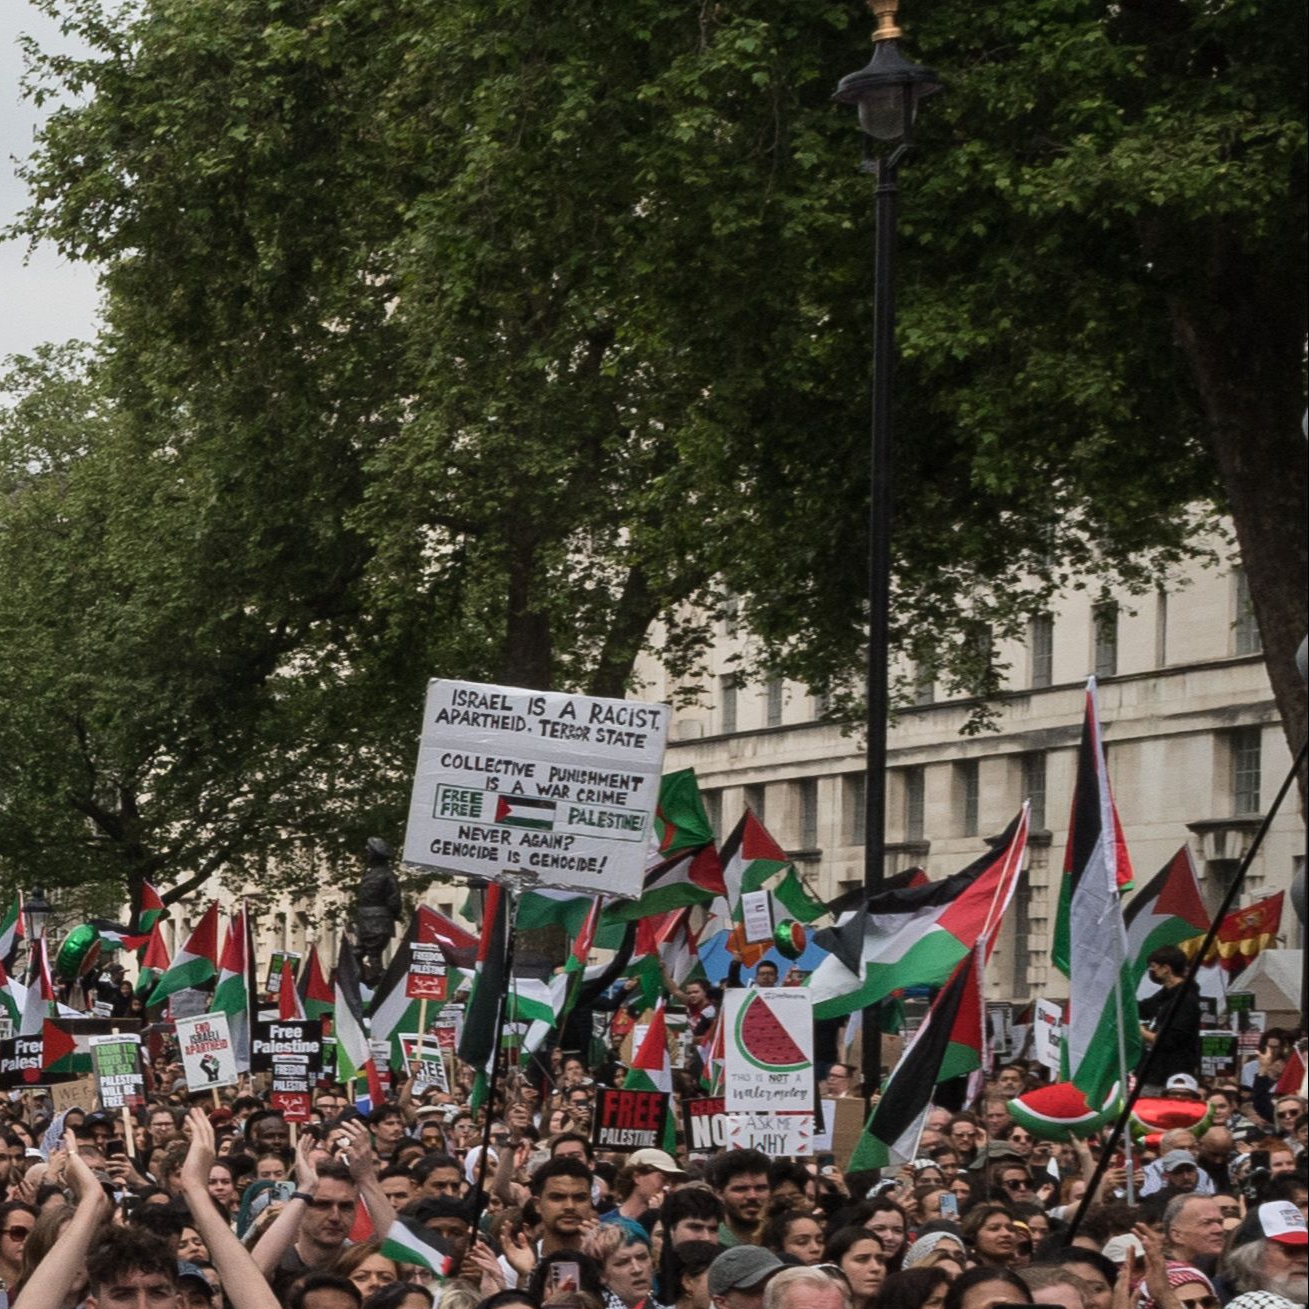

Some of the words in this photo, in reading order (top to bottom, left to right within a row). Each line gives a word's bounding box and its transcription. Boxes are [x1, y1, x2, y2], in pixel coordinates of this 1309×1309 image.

[451, 688, 514, 712] ISRAEL
[528, 696, 547, 717] IS
[558, 700, 577, 720] A
[539, 719, 591, 742] TERROR
[595, 728, 647, 749] STATE
[440, 752, 536, 779] COLLECTIVE
[548, 765, 644, 793] PUNISHMENT
[441, 788, 484, 804] FREE
[485, 776, 500, 792] IS
[510, 781, 525, 796] A
[535, 783, 570, 800] WAR
[575, 787, 629, 807] CRIME
[439, 802, 483, 819] FREE
[567, 806, 646, 832] PALESTINE!
[457, 825, 512, 846] NEVER
[519, 832, 576, 852] AGAIN?
[429, 838, 499, 862] GENOCIDE
[507, 850, 521, 864] IS
[528, 855, 609, 875] GENOCIDE!
[194, 1021, 211, 1034] END
[269, 1024, 303, 1039] Free
[185, 1039, 229, 1056] APARTHEID
[252, 1040, 320, 1054] Palestine
[274, 1064, 307, 1076] FREEDOM
[417, 1062, 444, 1079] REE
[100, 1074, 144, 1087] PALESTINE
[273, 1080, 309, 1092] PALESTINE
[768, 1073, 790, 1085] NOT
[101, 1086, 122, 1097] WILL
[123, 1085, 137, 1096] BE
[102, 1096, 124, 1108] FREE
[602, 1090, 663, 1130] FREE
[690, 1113, 727, 1148] NO
[746, 1115, 772, 1130] ASK
[599, 1127, 658, 1147] PALESTINE
[749, 1133, 788, 1155] WHY
